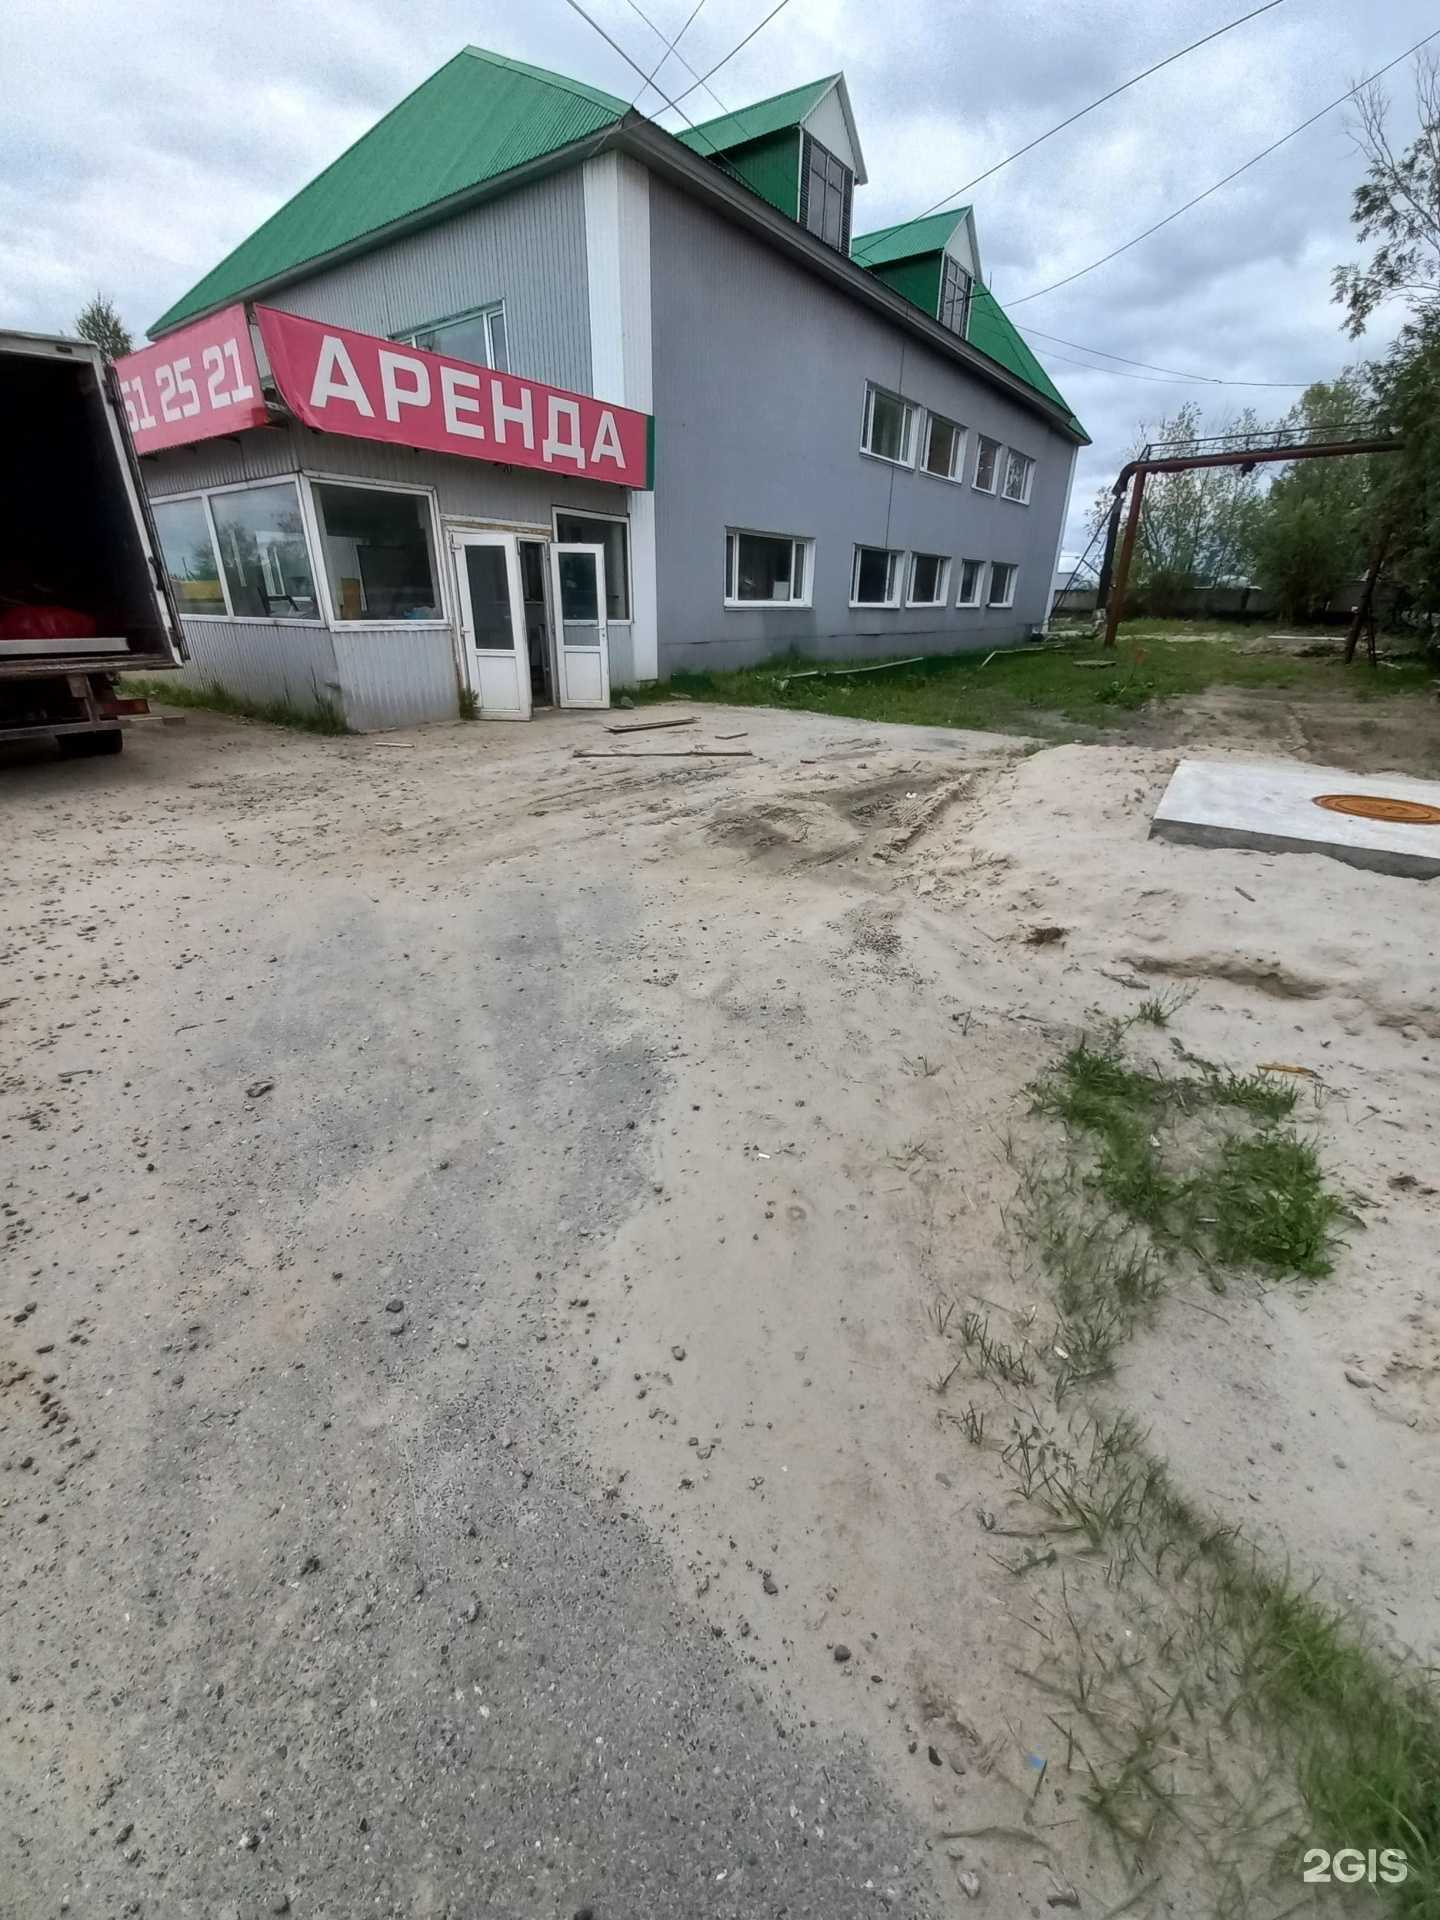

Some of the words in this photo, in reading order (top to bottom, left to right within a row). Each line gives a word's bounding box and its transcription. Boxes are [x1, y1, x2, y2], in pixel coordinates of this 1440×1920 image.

[155, 357, 200, 423] 25
[202, 338, 254, 409] 21
[310, 335, 627, 470] АРЕНДА
